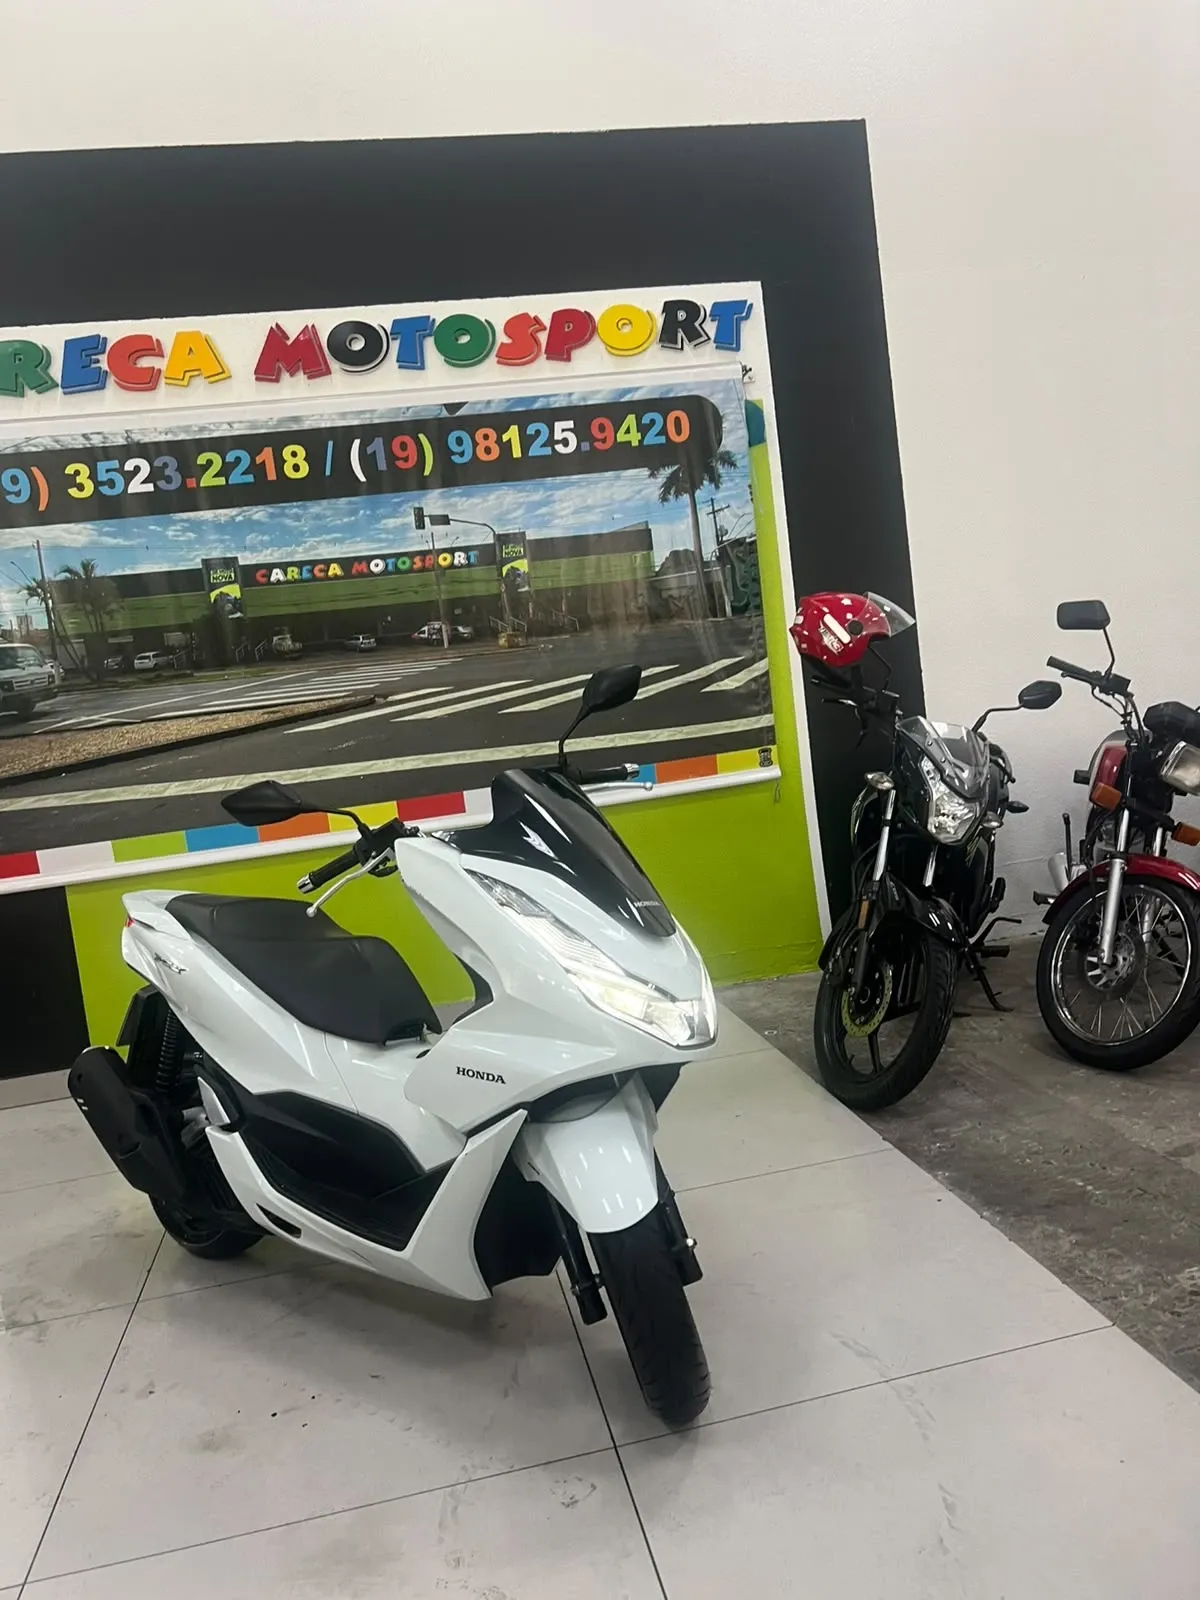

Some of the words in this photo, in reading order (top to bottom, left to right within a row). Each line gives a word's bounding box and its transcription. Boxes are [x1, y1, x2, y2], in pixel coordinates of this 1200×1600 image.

[0, 330, 231, 397] RECA
[254, 300, 753, 383] MOTOSPORT
[1, 466, 49, 512] 9)
[65, 444, 309, 498] 3523.2218
[325, 440, 334, 476] /
[350, 433, 433, 482] (19)
[447, 410, 690, 464] 98125.9420
[256, 563, 344, 584] CARECA
[352, 551, 479, 575] MOTOSPORT
[456, 1066, 506, 1084] HONDA
